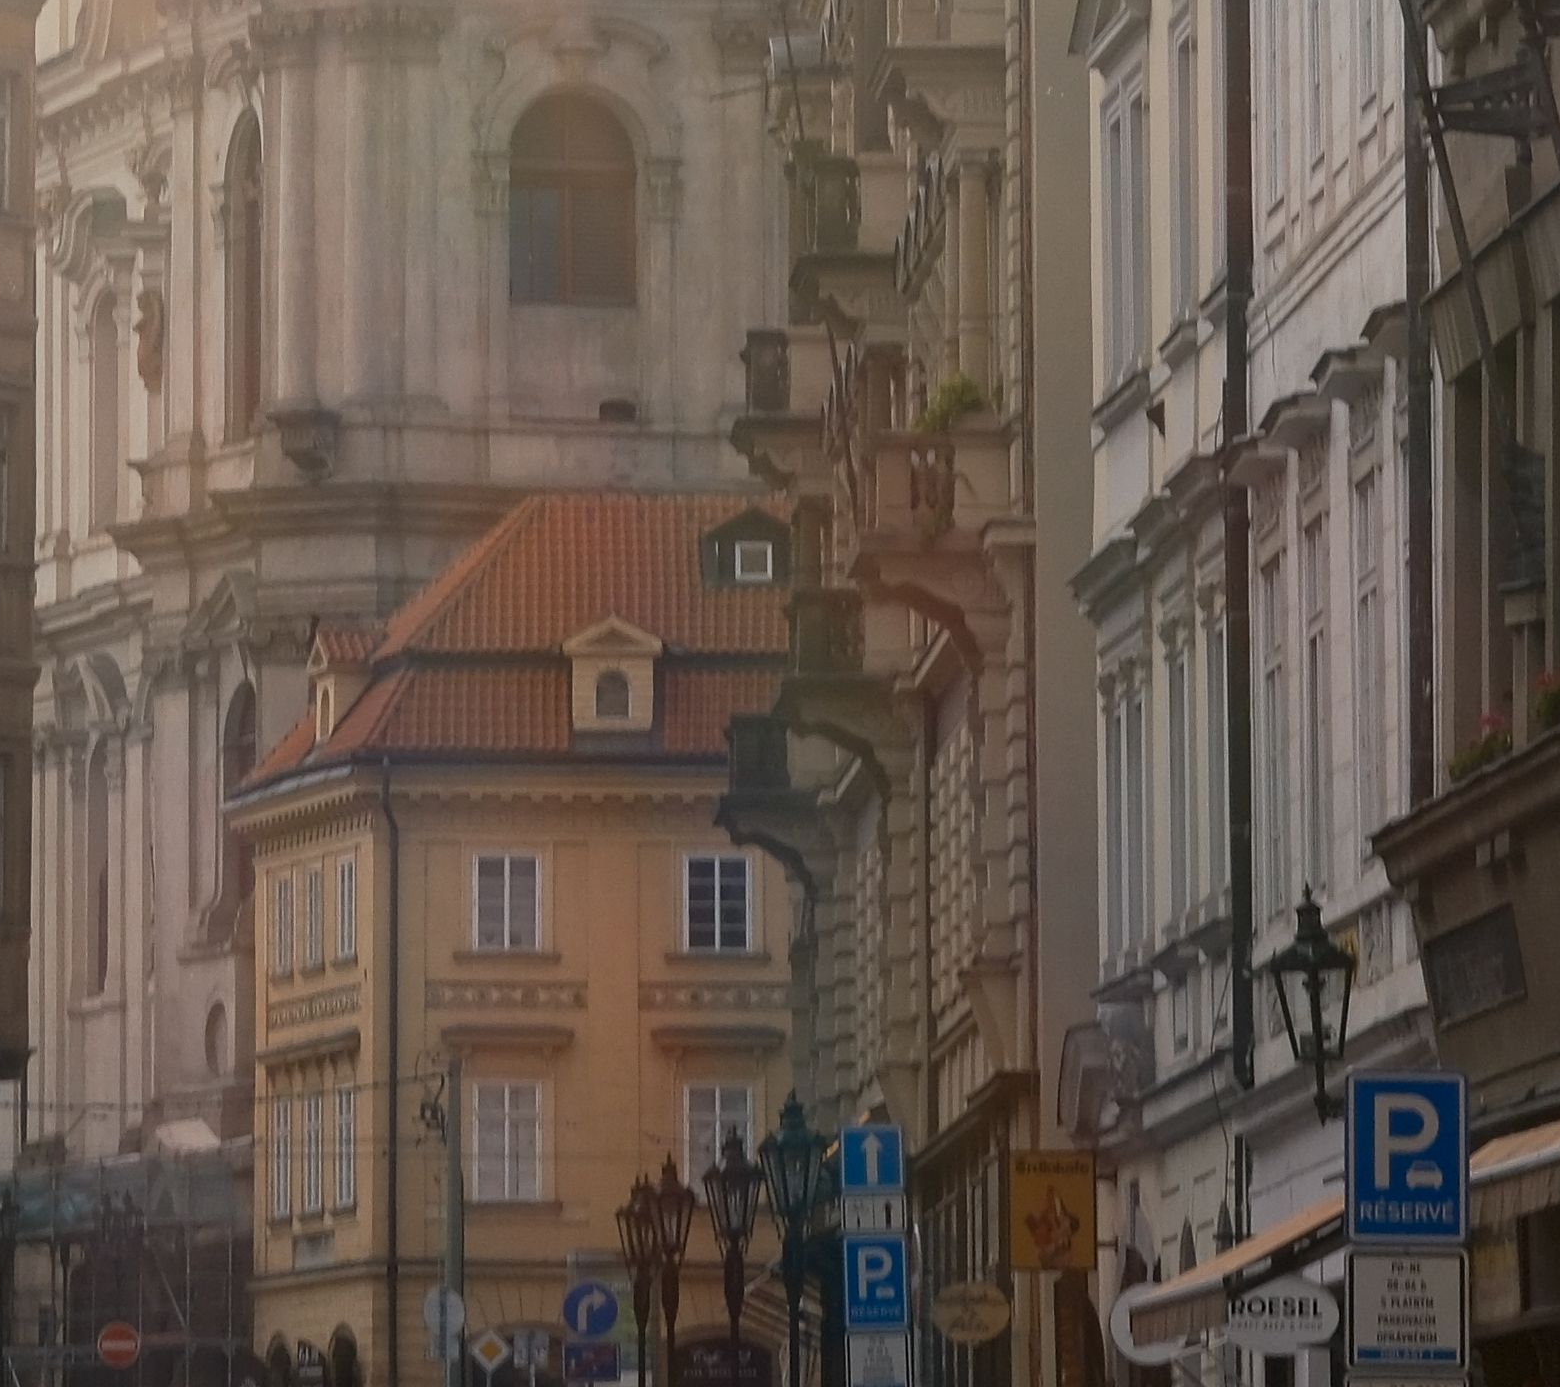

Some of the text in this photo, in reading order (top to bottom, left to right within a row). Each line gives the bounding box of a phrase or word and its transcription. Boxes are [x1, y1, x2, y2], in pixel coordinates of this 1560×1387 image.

[1374, 1093, 1439, 1191] P
[1360, 1197, 1453, 1224] RÉSERVÉ
[857, 1246, 893, 1301] P
[1231, 1296, 1323, 1318] ROESEL
